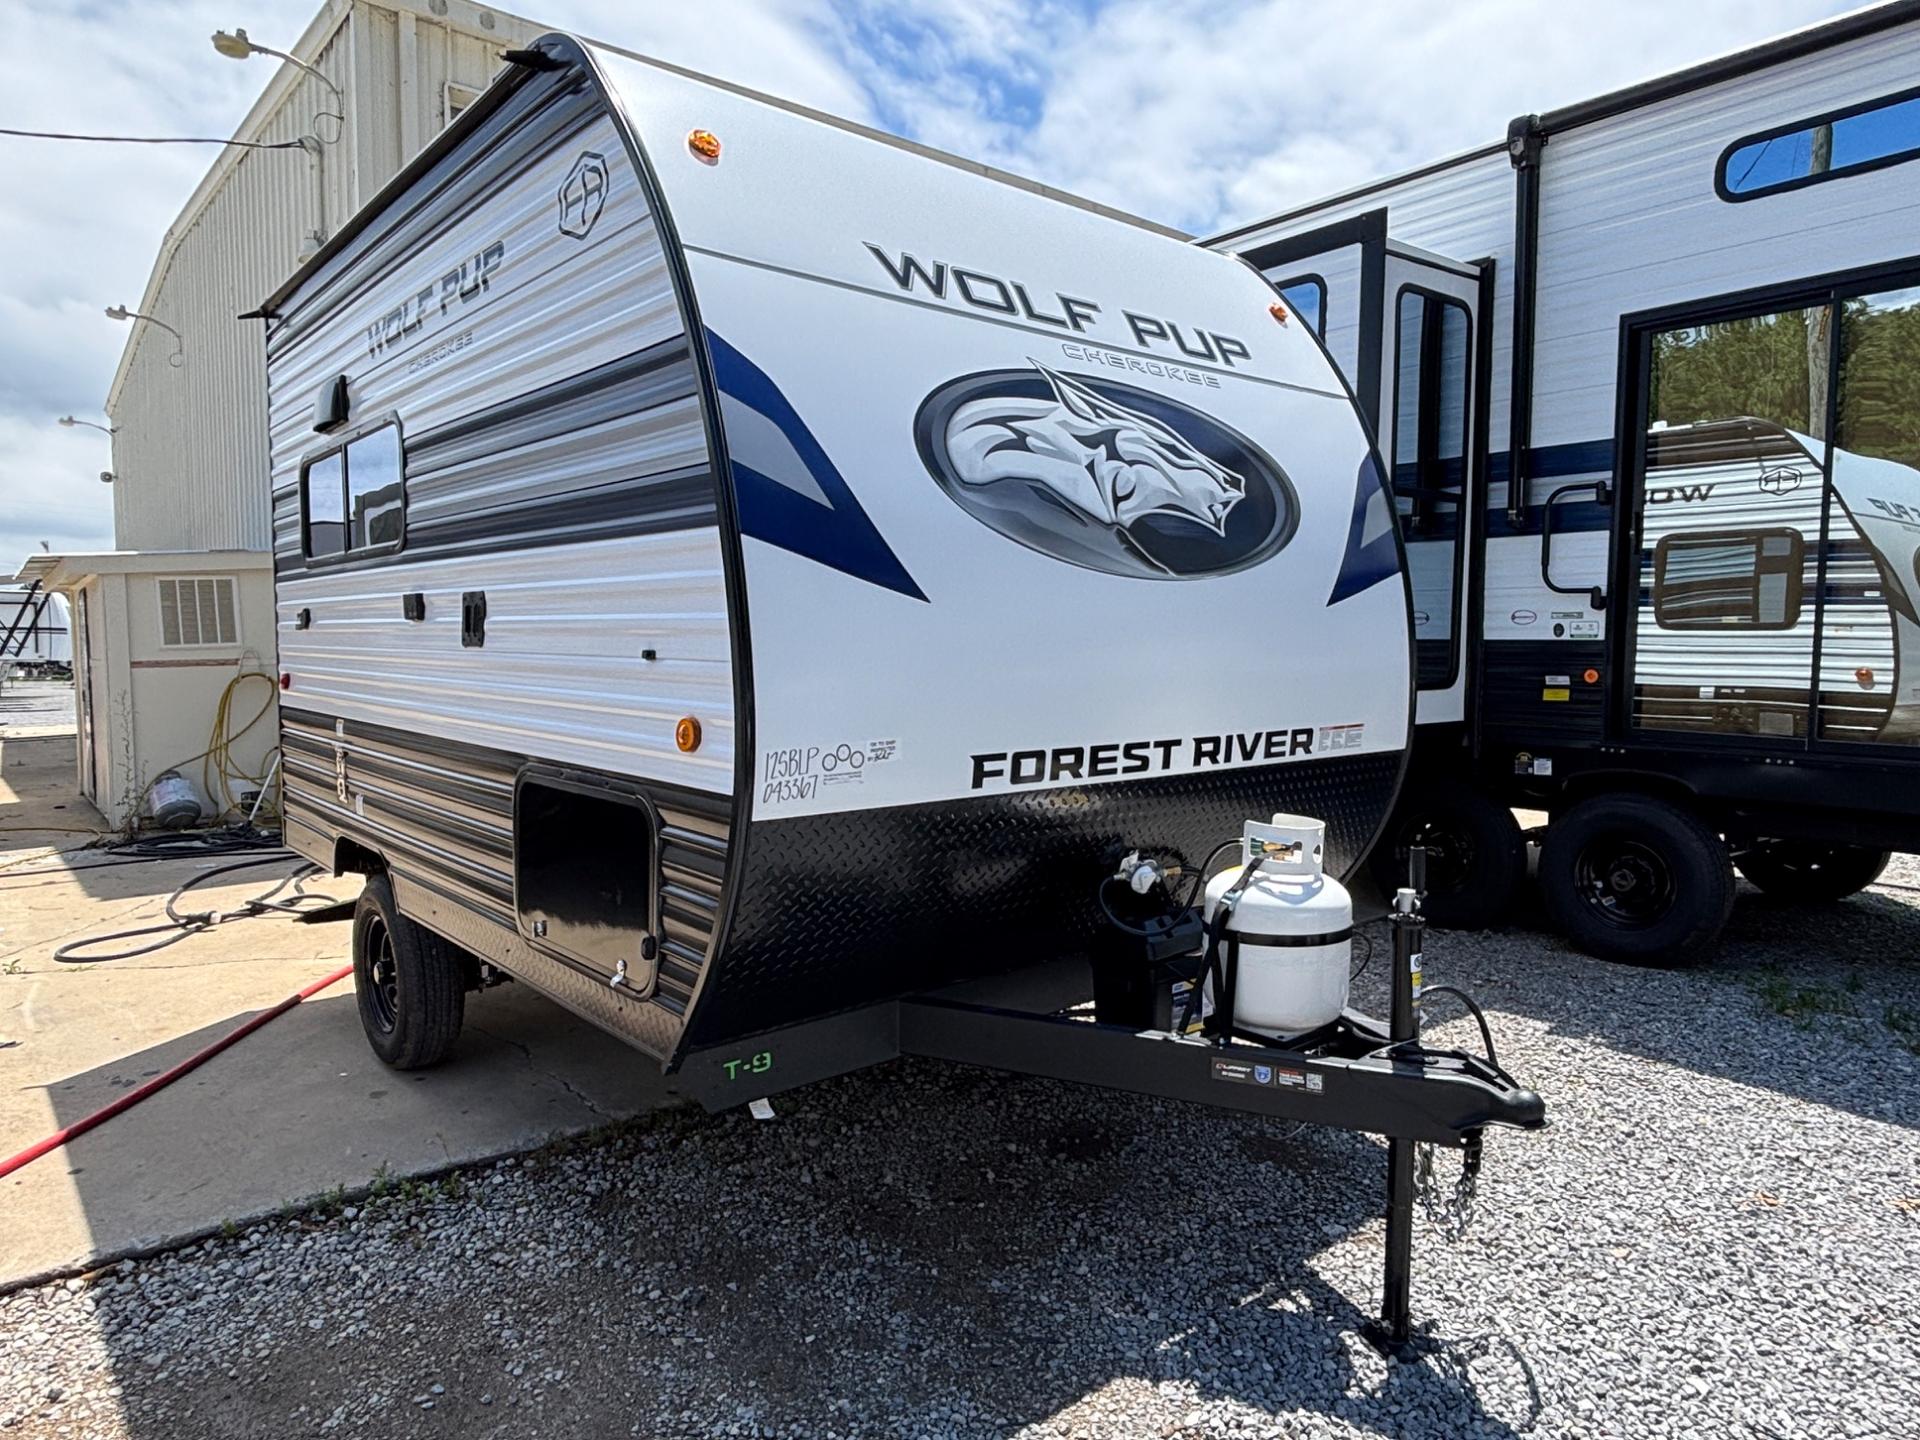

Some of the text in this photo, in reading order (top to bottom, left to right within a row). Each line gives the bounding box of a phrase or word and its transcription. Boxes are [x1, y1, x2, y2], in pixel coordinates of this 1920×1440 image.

[367, 240, 504, 359] WOLF PUP
[863, 241, 1251, 367] WOLF PUP
[1062, 343, 1222, 389] CHEROKEE
[970, 738, 1182, 789] FOREST
[1192, 727, 1314, 768] RIVER
